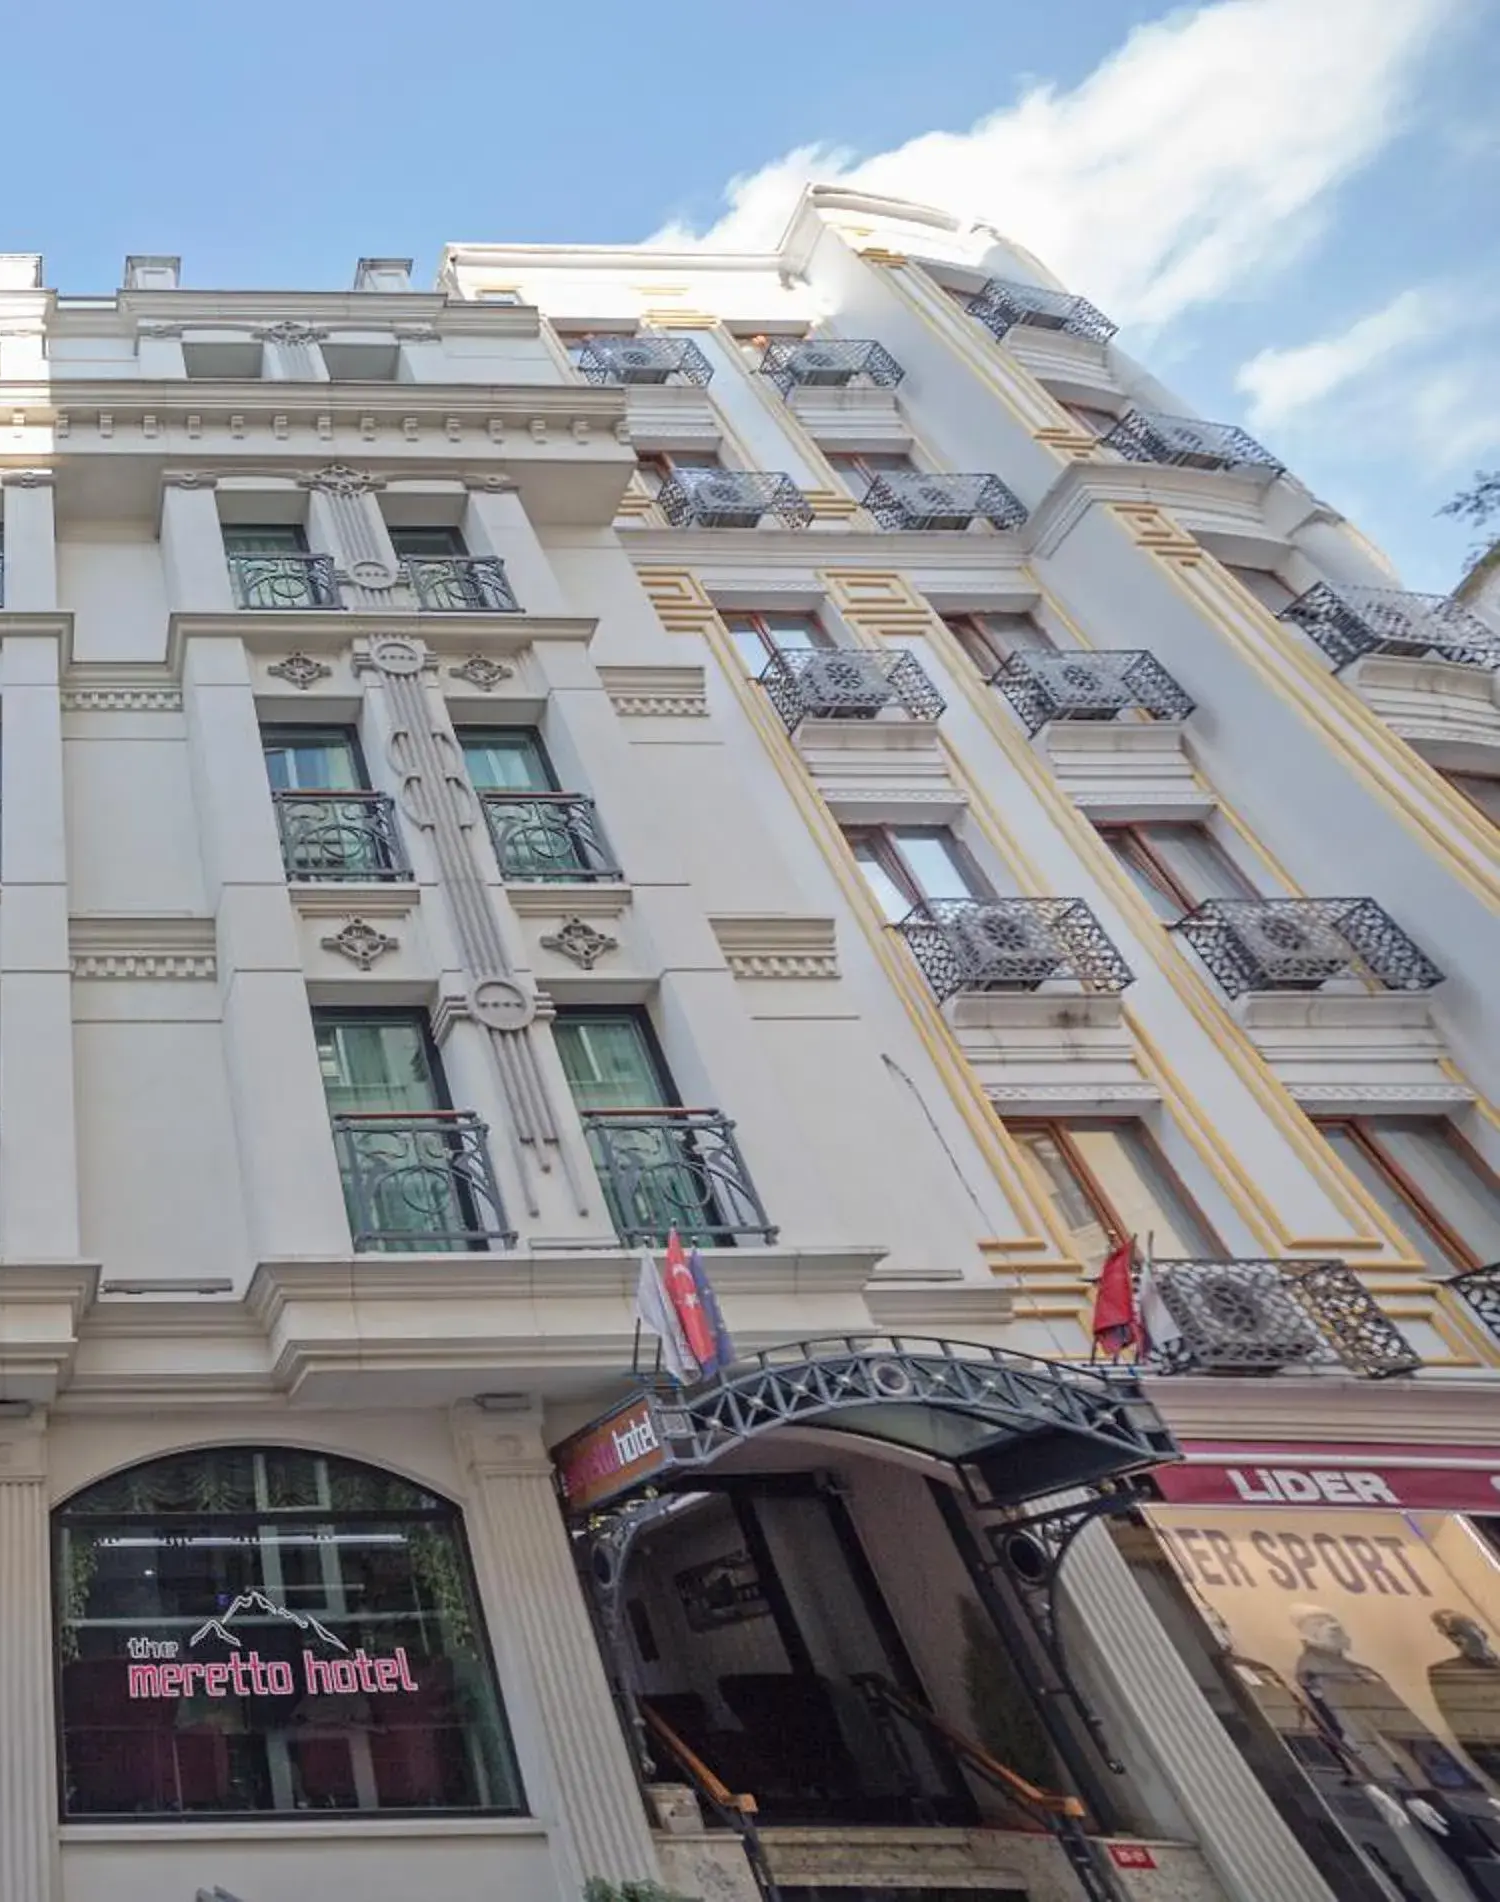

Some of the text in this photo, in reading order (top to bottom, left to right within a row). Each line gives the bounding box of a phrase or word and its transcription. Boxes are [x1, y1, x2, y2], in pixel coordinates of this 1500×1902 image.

[611, 1410, 659, 1466] hotel
[1251, 1529, 1433, 1597] SPORT
[127, 1637, 179, 1659] the
[128, 1647, 418, 1697] meretto hotel
